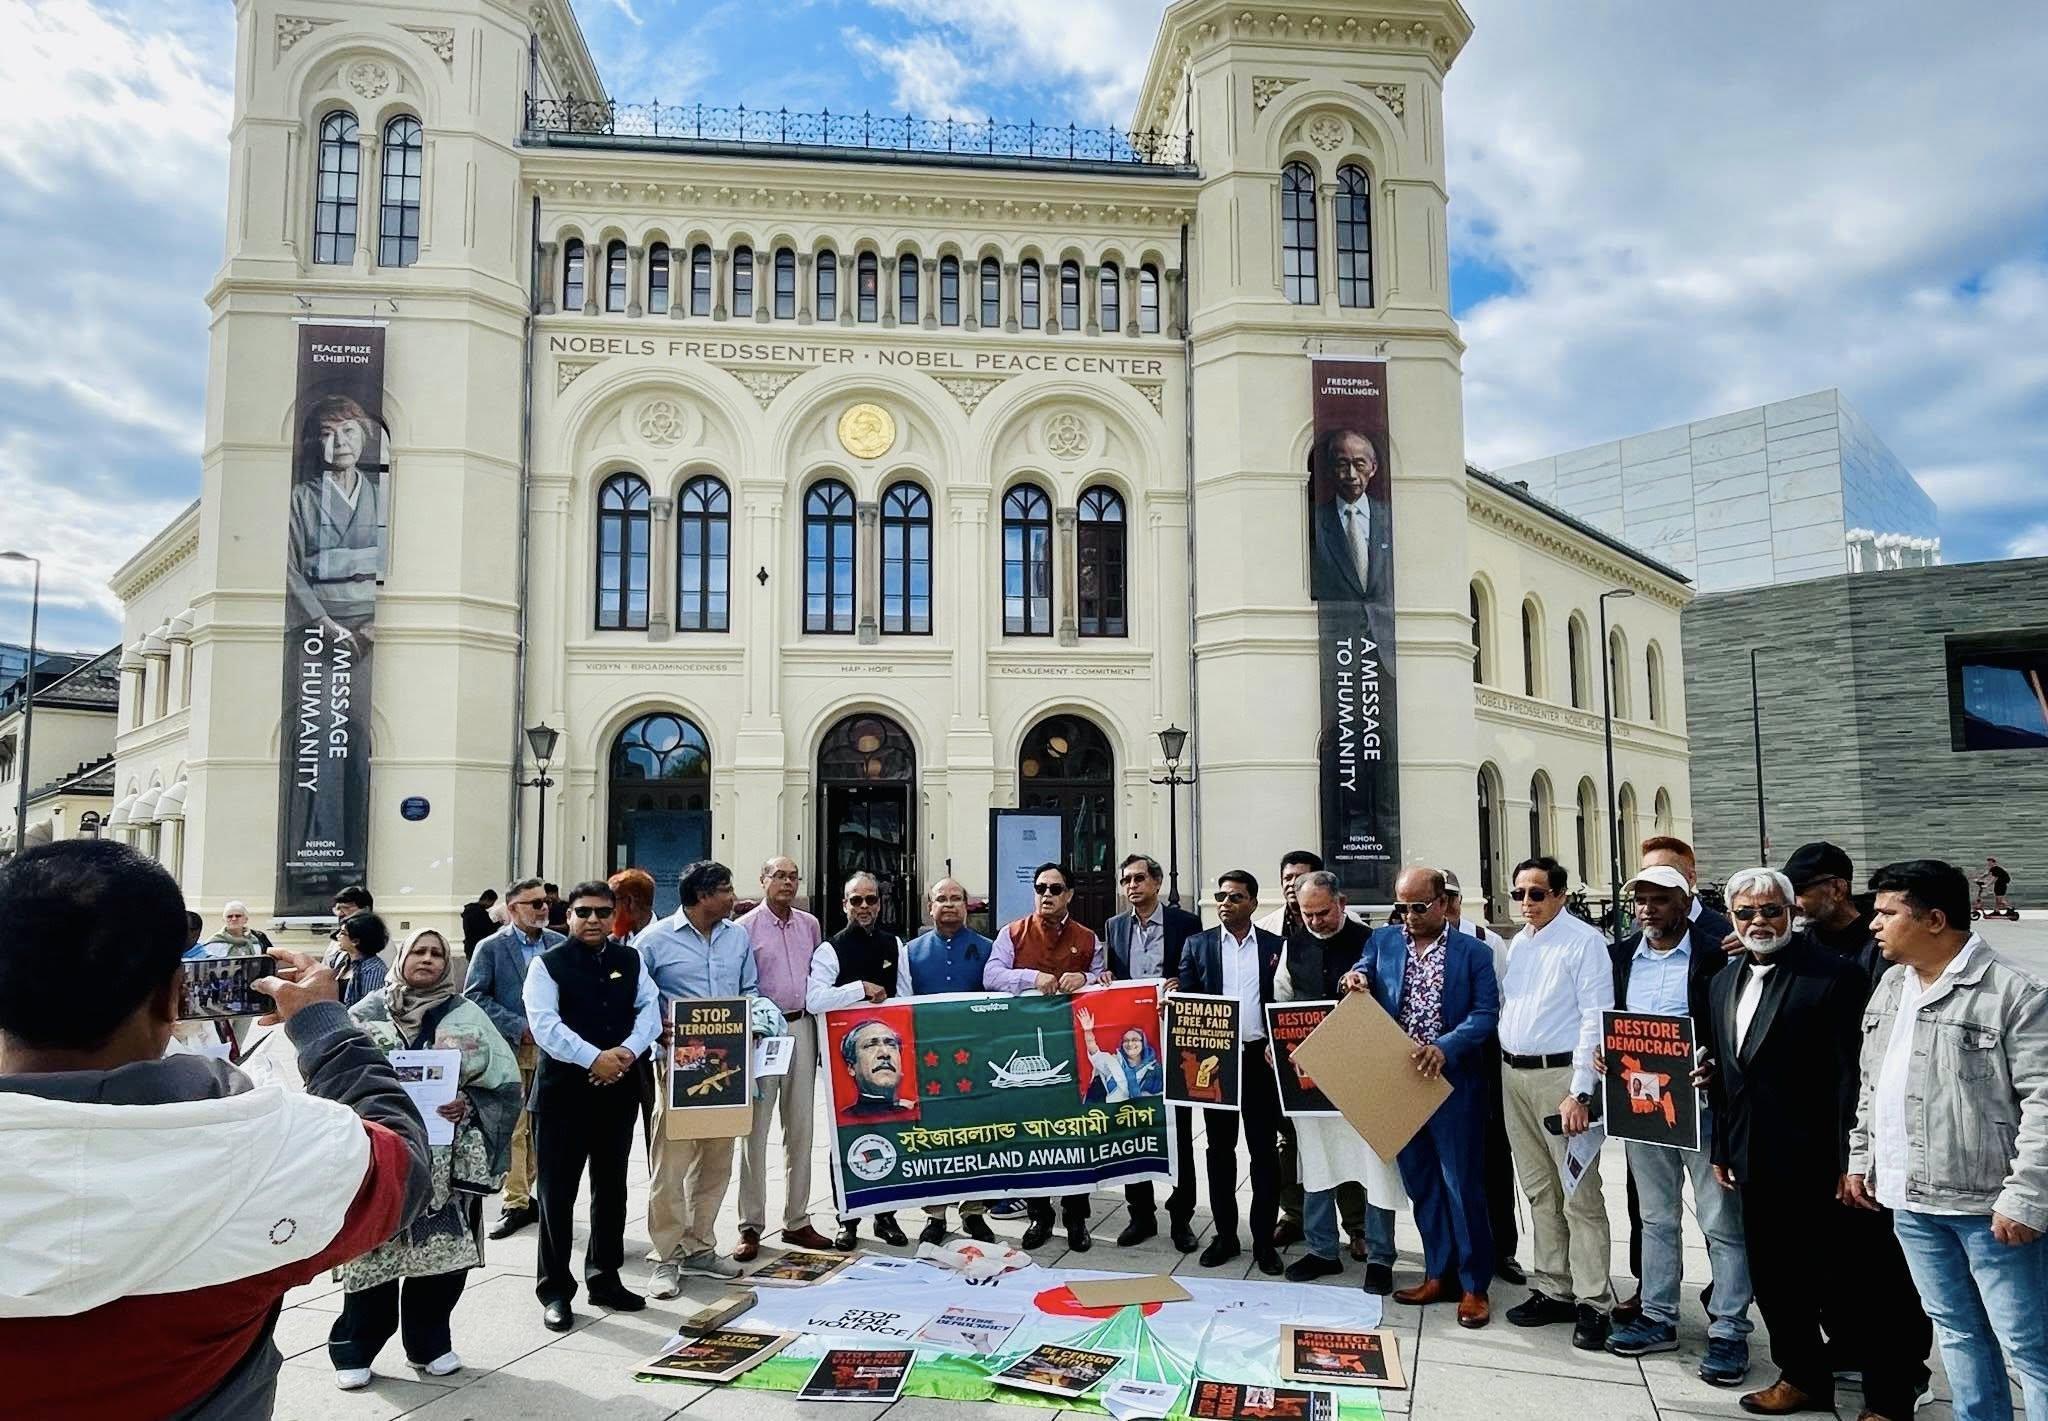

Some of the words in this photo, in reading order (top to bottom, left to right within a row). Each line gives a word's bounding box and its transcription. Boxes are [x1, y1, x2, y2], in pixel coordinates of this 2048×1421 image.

[311, 344, 342, 353] PEACE
[344, 345, 371, 354] PRIZE
[550, 336, 656, 356] NOBELS
[669, 341, 855, 363] FREDSSENTER
[879, 350, 963, 368] NOBEL
[976, 353, 1058, 371] PEACE
[1064, 357, 1162, 375] CENTER
[312, 354, 369, 364] EXHIBITION
[1326, 378, 1374, 387] FREDSPRIS-
[1321, 387, 1380, 396] UTSTILLINGEN
[303, 624, 324, 655] TO
[333, 625, 352, 643] A
[1336, 637, 1352, 666] TO
[1360, 637, 1377, 655] A
[1075, 668, 1136, 676] COMMITMENT
[328, 648, 352, 759] MESSAGE
[1475, 693, 1508, 710] NOBELS
[1360, 659, 1381, 761] MESSAGE
[297, 662, 323, 793] HUMANITY
[1336, 672, 1356, 792] HUMANITY
[305, 840, 336, 848] NIHON
[297, 849, 345, 857] HIDANKYO
[691, 1008, 731, 1022] STOP
[1175, 1001, 1232, 1018] DEMAND
[679, 1022, 743, 1036] TERRORISM
[1177, 1015, 1204, 1029] FREE,
[1206, 1017, 1229, 1029] FAIR
[1614, 1018, 1681, 1040] RESTORE
[1171, 1026, 1186, 1035] AND
[1187, 1028, 1199, 1036] ALL
[1200, 1029, 1235, 1039] INCLUSIVE
[1175, 1035, 1231, 1050] ELECTIONS
[1606, 1035, 1692, 1058] DEMOCRACY
[897, 1122, 1017, 1153] সুইজারল্যান্ড
[1022, 1108, 1110, 1139] আওয়ামী
[1115, 1104, 1156, 1128] লীগ
[901, 1150, 1024, 1178] SWITZERLAND
[1028, 1147, 1085, 1167] AWAMI
[1090, 1136, 1159, 1163] LEAGUE
[838, 1316, 890, 1326] MOB
[843, 1309, 901, 1320] STOP
[807, 1319, 910, 1337] VIOLENCE
[718, 1334, 760, 1344] STOP
[1297, 1338, 1379, 1351] MINORITIES
[1303, 1332, 1372, 1343] PROTECT
[1040, 1346, 1060, 1357] DE
[1060, 1350, 1114, 1366] CENSOR
